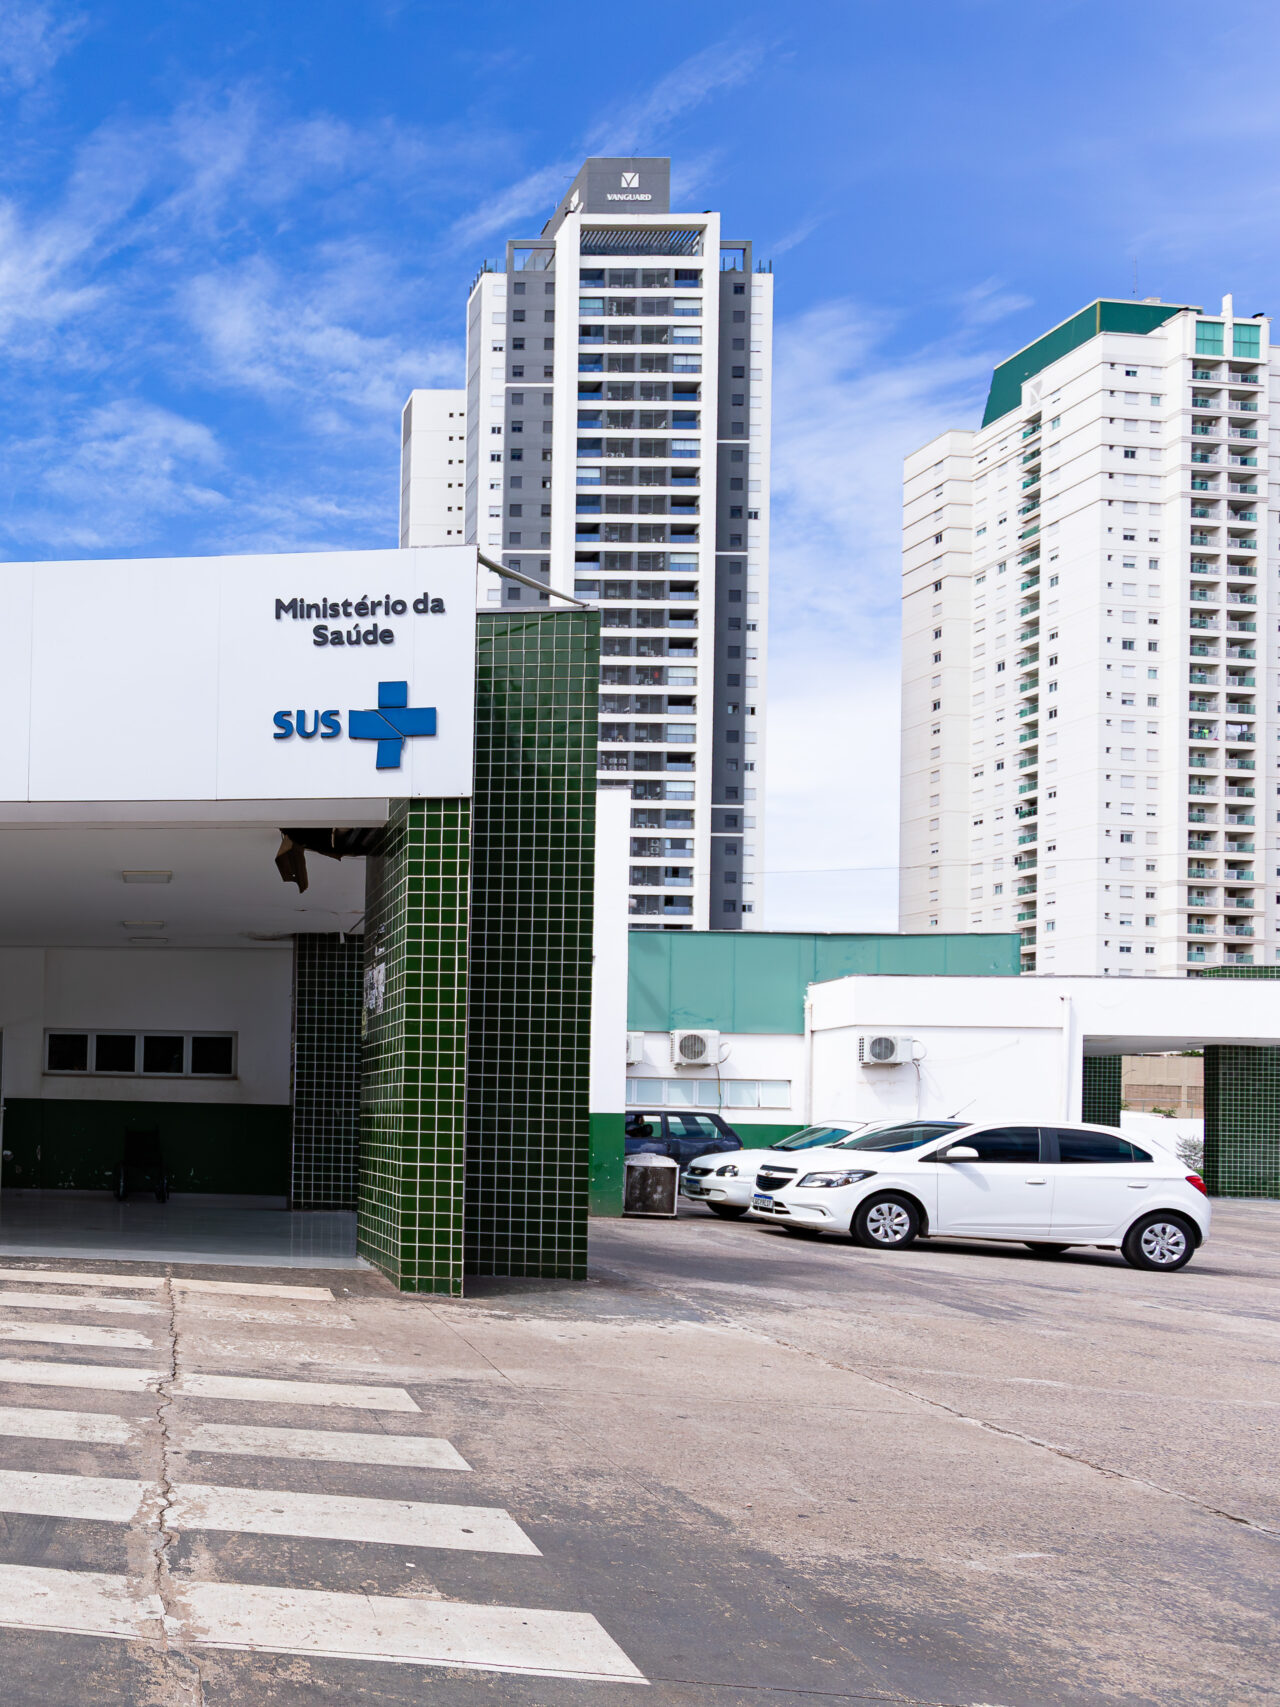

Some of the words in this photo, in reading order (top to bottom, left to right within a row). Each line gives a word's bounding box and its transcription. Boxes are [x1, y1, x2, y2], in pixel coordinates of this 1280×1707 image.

[606, 193, 652, 201] VANGUARD
[274, 594, 408, 620] Ministério
[412, 592, 446, 615] da
[312, 623, 394, 647] Saúde
[272, 709, 342, 739] SUS
